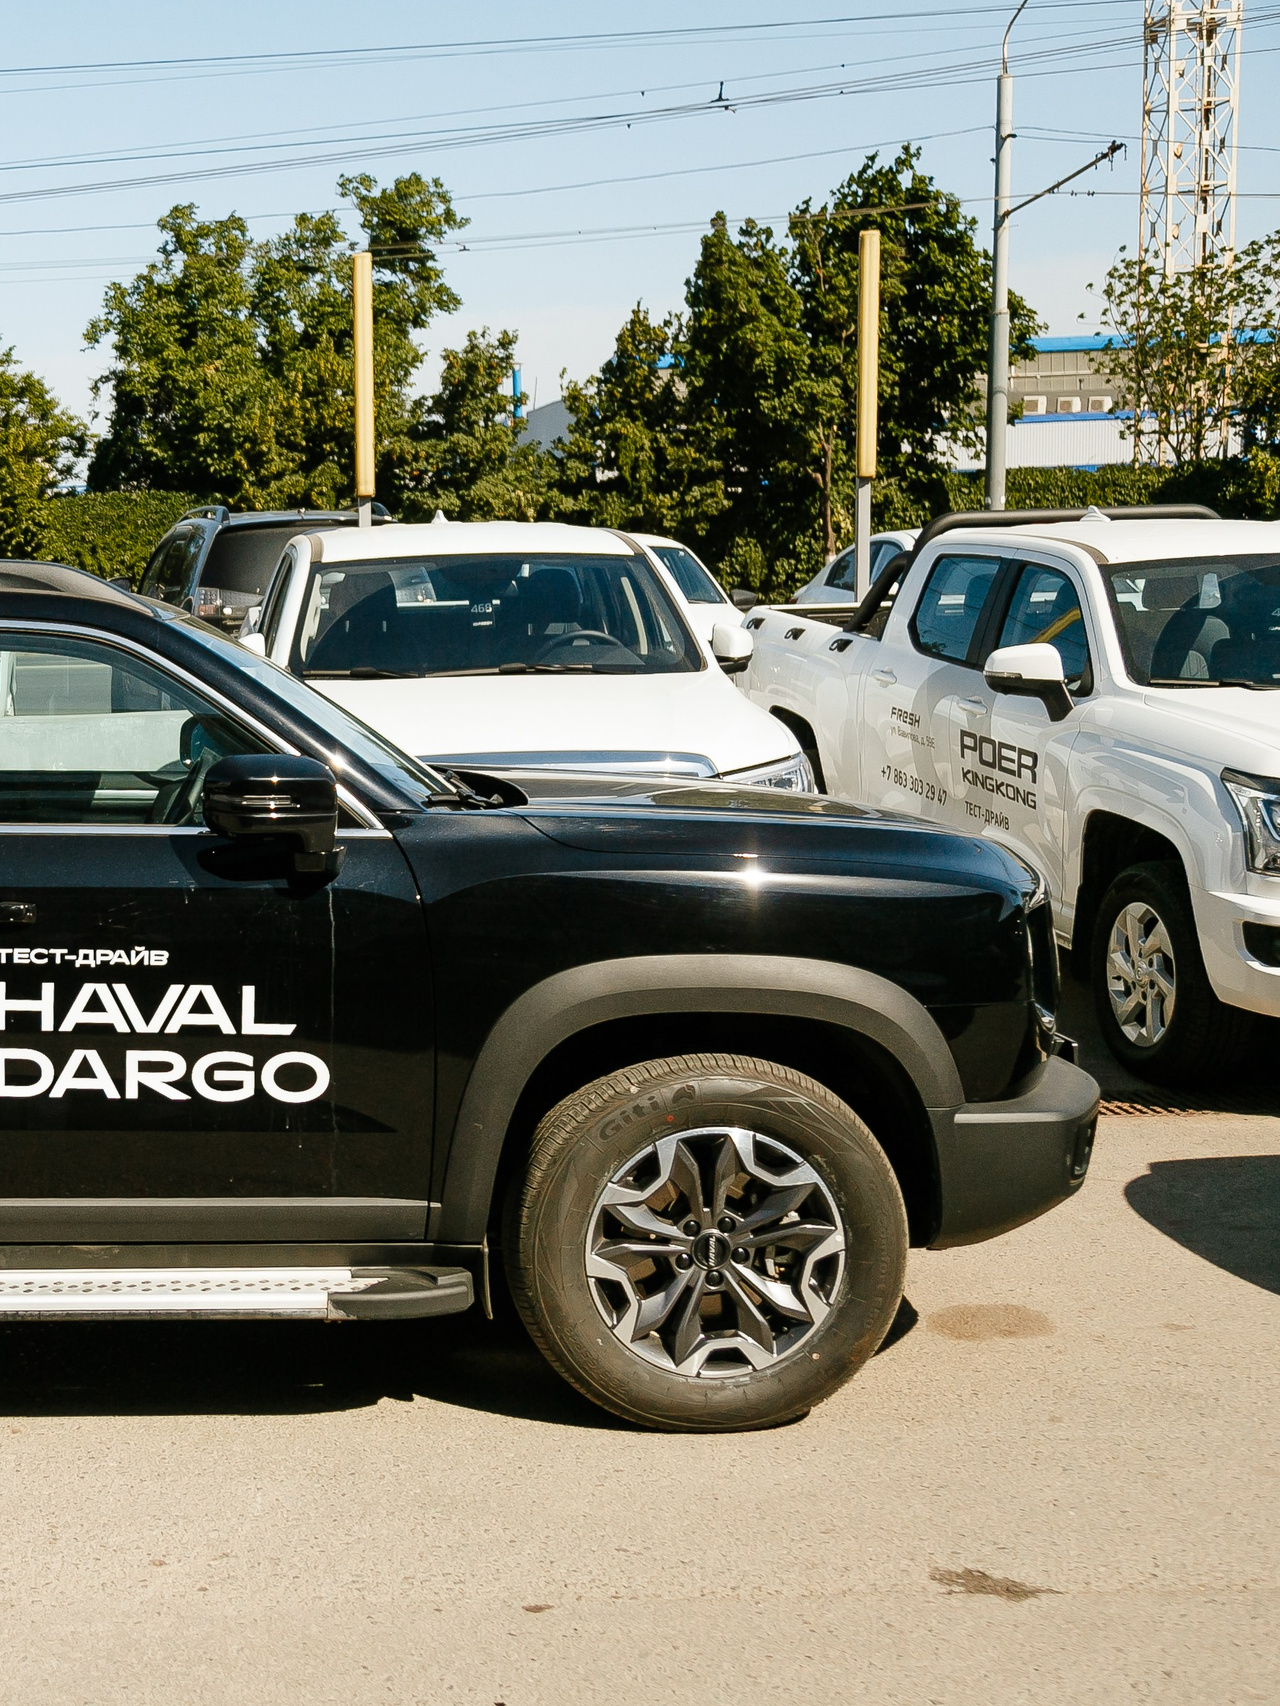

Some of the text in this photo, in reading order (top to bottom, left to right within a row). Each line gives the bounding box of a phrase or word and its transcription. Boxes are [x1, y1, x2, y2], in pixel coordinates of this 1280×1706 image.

[960, 729, 1039, 784] POER
[881, 765, 948, 807] +7 863 303 29 47
[962, 766, 1037, 810] KINGKONG
[964, 800, 1010, 831] ТЕСТ-ДРАЙВ
[598, 1095, 661, 1141] Giti
[708, 1235, 717, 1267] HAVAL
